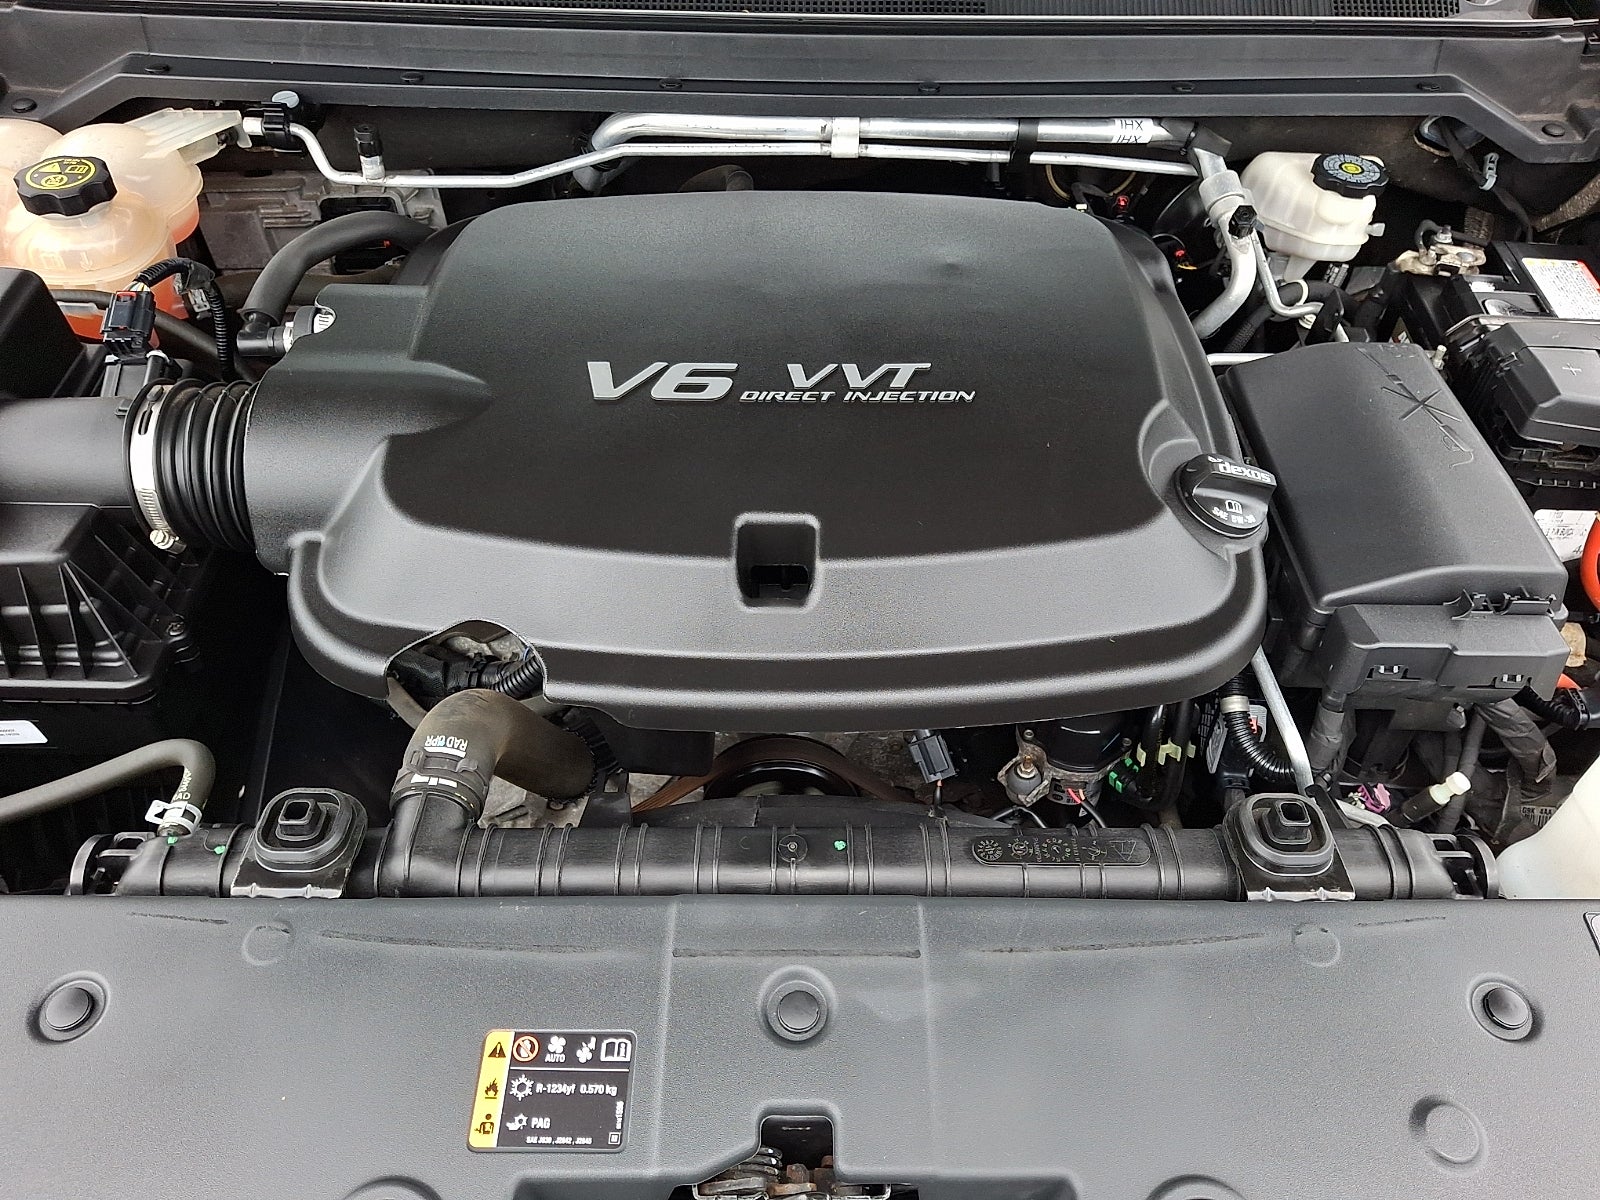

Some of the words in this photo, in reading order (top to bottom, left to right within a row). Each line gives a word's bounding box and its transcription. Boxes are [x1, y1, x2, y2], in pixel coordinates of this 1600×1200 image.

[586, 361, 739, 401] V6
[786, 363, 932, 389] VVT
[739, 390, 837, 402] DIRECT
[842, 390, 976, 402] INJECTION
[1219, 461, 1271, 482] dexos
[446, 736, 468, 751] RAD
[544, 1053, 566, 1063] AUTO
[535, 1083, 576, 1096] R-1234yf
[580, 1084, 605, 1094] 0.570
[605, 1084, 618, 1097] kg
[531, 1117, 550, 1129] PAG
